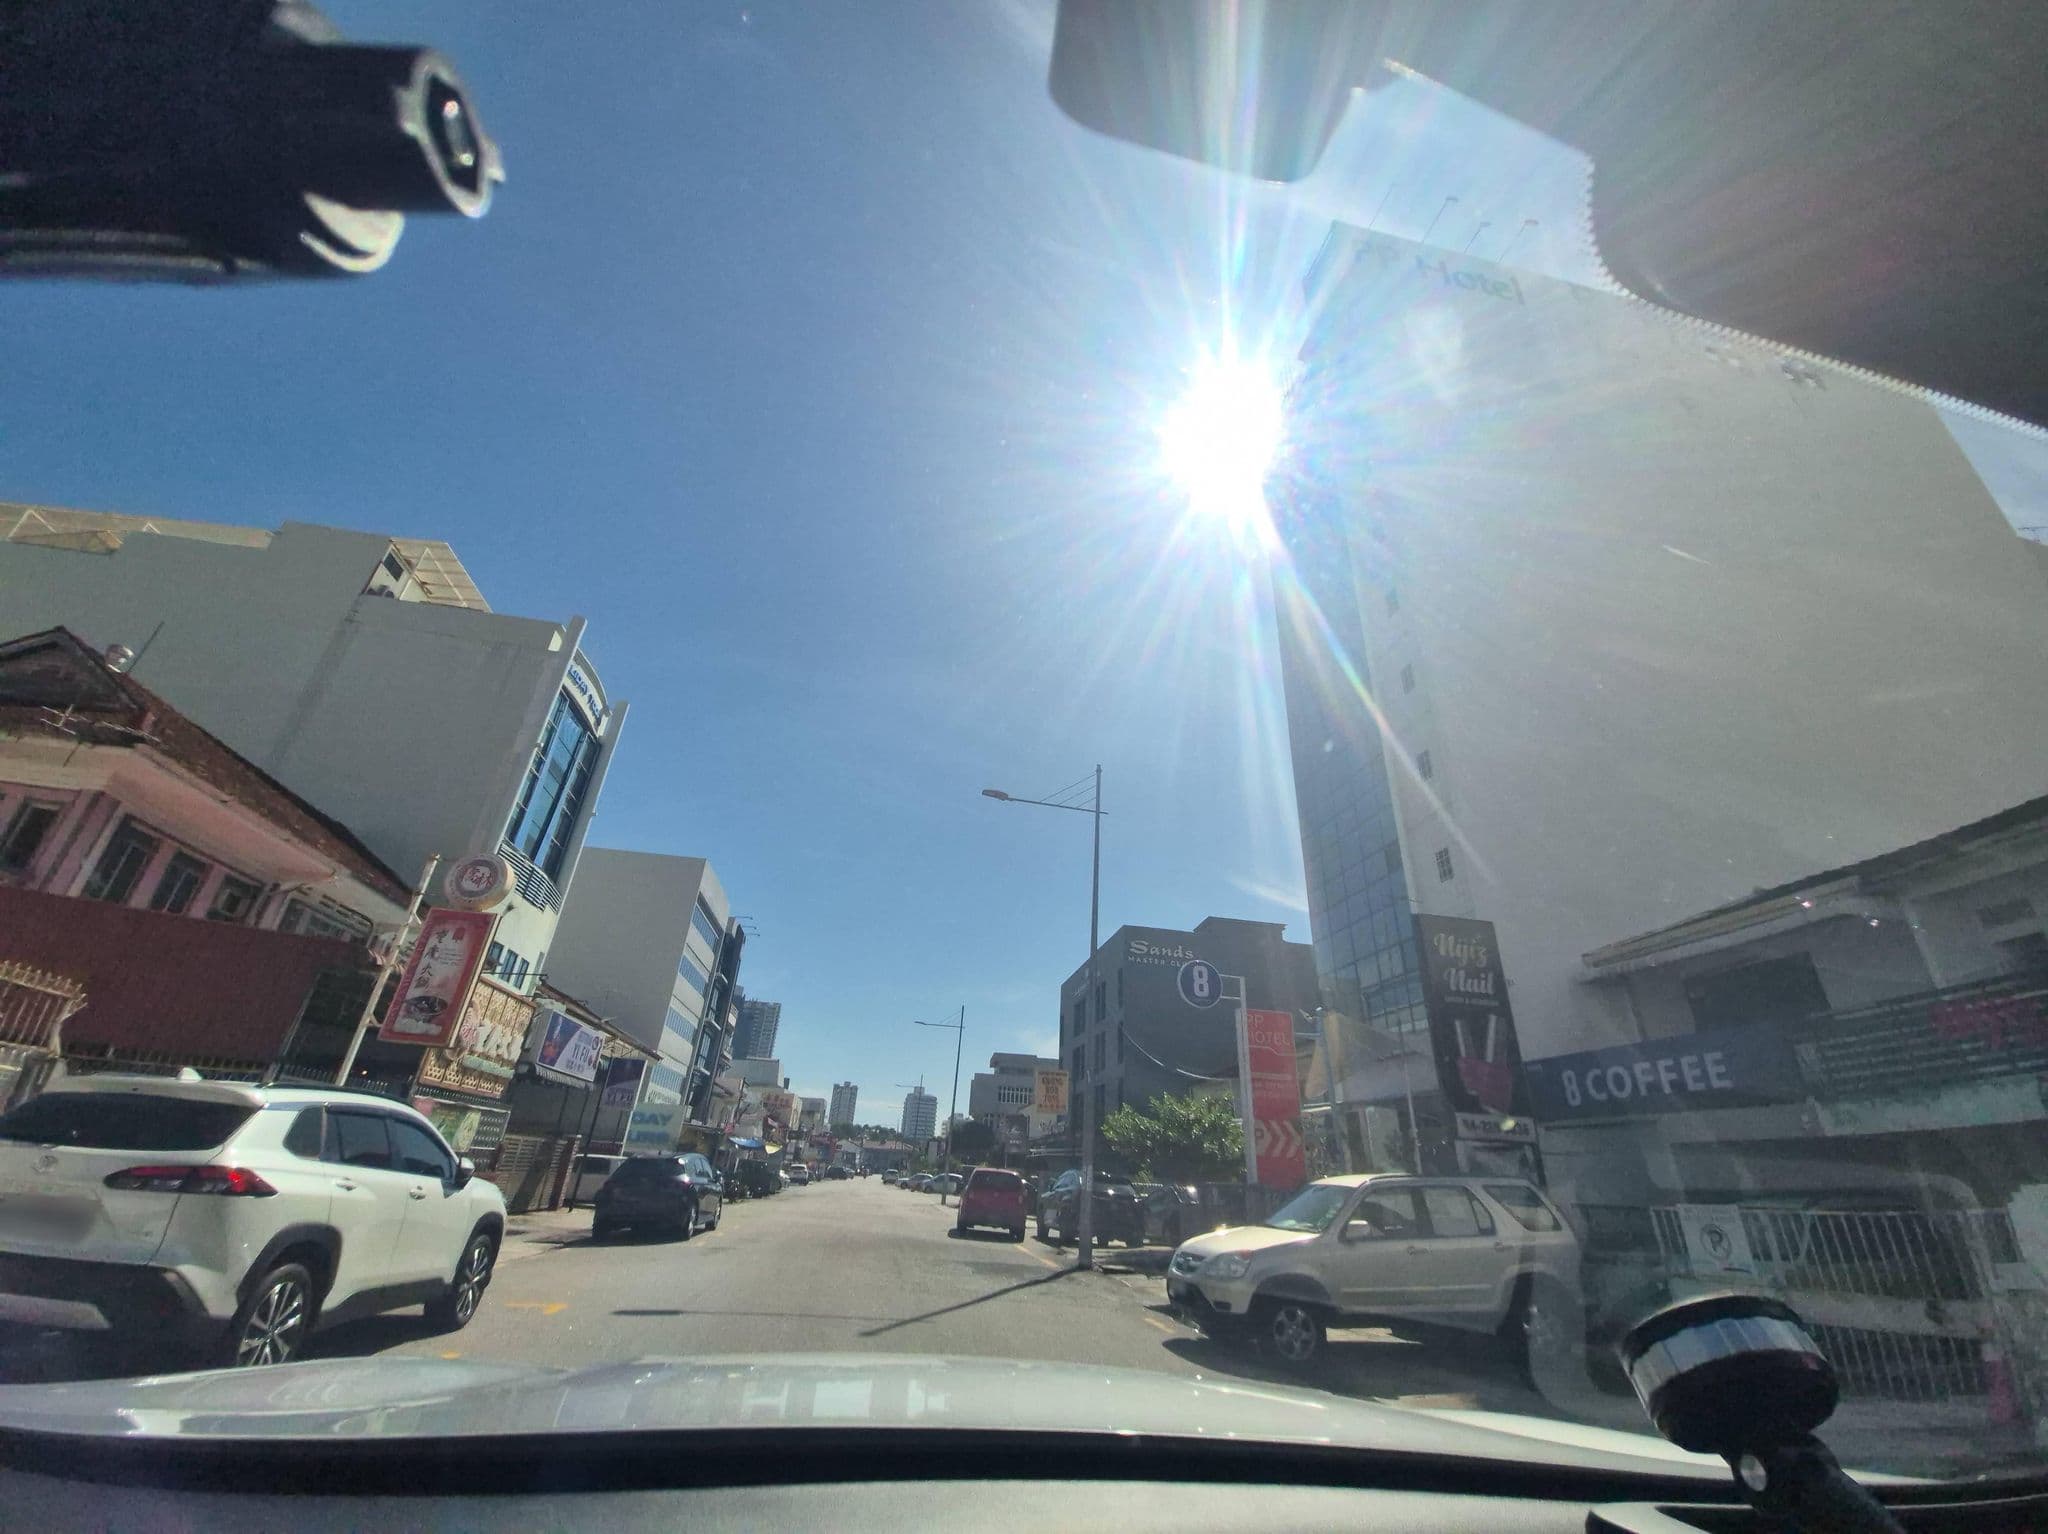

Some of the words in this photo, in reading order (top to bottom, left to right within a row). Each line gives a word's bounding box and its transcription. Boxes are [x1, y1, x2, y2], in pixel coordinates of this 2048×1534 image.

[1415, 253, 1526, 305] Hotel
[1127, 956, 1165, 966] MASTER
[1129, 940, 1194, 959] Sands
[1192, 965, 1210, 998] 8
[1444, 968, 1494, 994] Nail
[1561, 1069, 1582, 1107] 8
[1586, 1052, 1734, 1101] COFFEE
